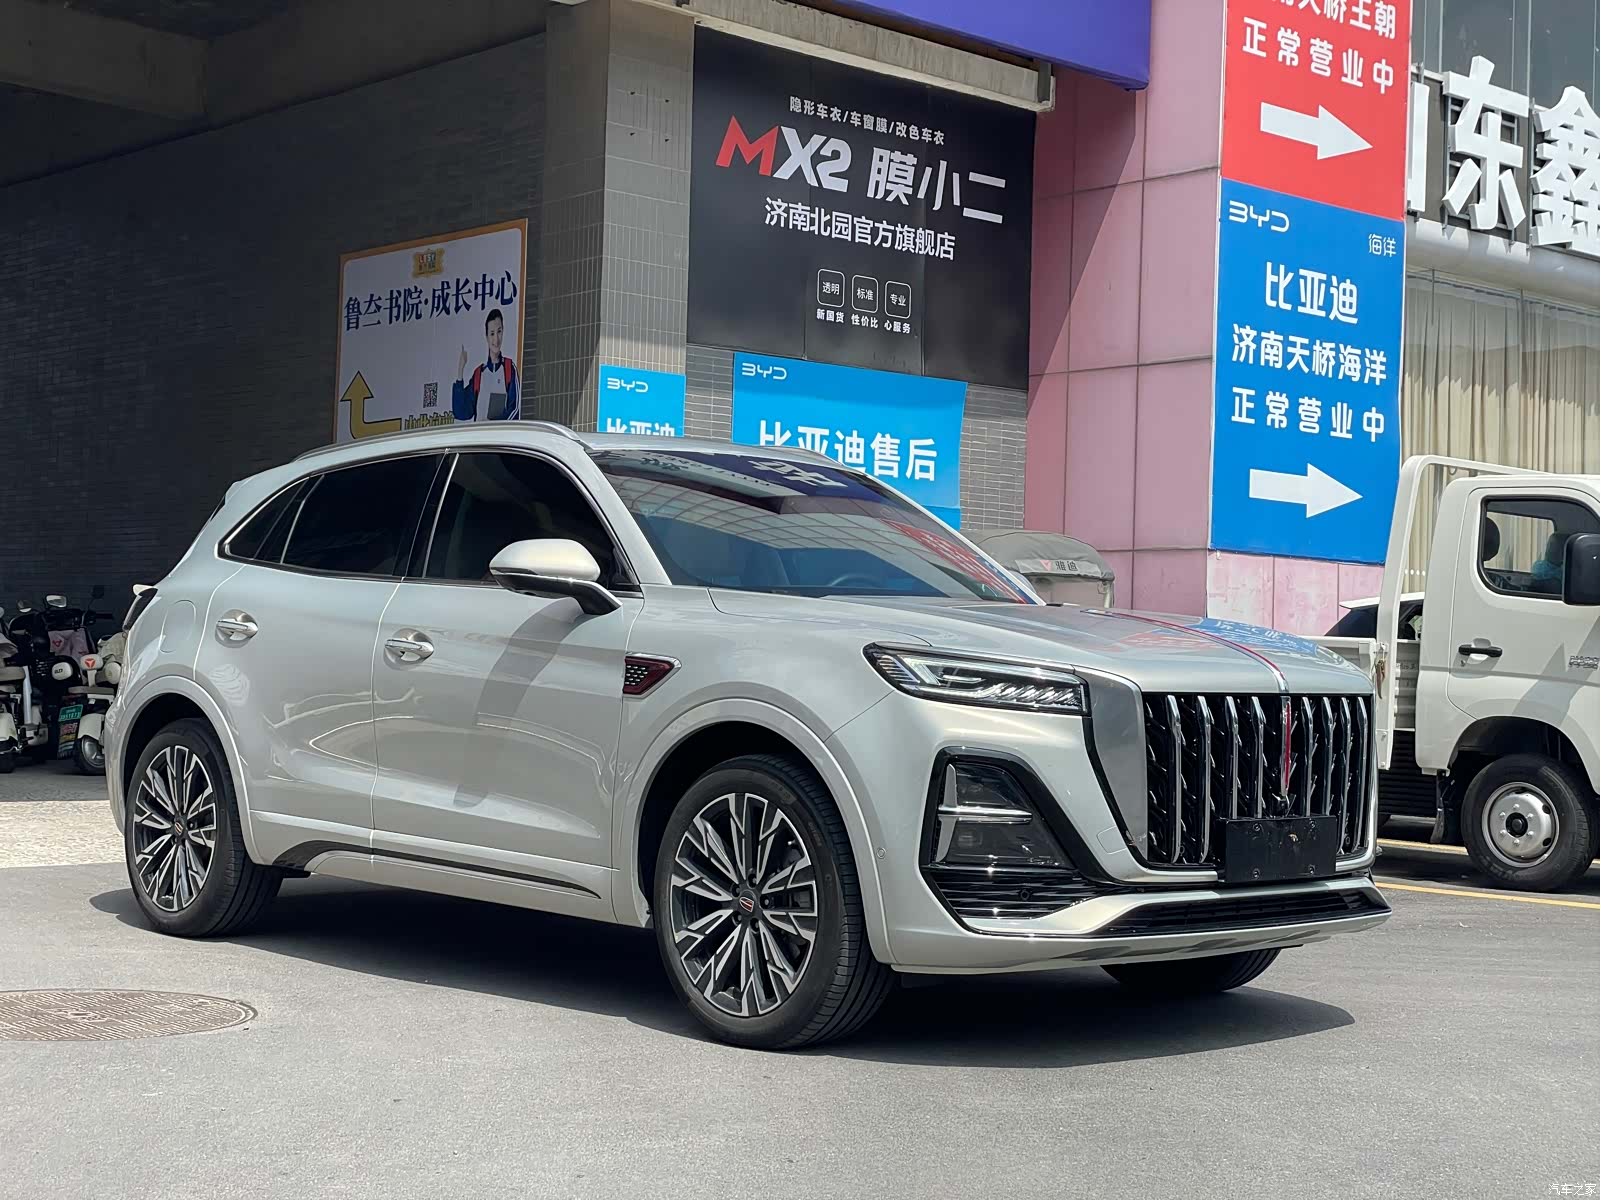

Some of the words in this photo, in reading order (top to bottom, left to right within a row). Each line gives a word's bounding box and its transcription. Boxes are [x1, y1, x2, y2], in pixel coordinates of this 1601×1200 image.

[1243, 17, 1394, 94] 正常营业中
[790, 96, 945, 145] 隐形车衣/车窗膜/改色车衣
[715, 115, 852, 192] MX2
[867, 147, 1006, 223] 膜小二
[1405, 55, 1600, 256] 东鑫
[765, 197, 956, 260] 济南北园官方旗舰店
[1229, 200, 1290, 232] BYD
[1368, 234, 1397, 257] 海洋
[822, 281, 840, 295] 透明
[856, 288, 874, 301] 标准
[890, 294, 907, 307] 专业
[1265, 262, 1359, 324] 比亚迪
[816, 308, 845, 323] 新国货
[851, 313, 879, 328] 性价比
[883, 319, 911, 334] 心服务
[742, 362, 788, 380] BYD
[1232, 323, 1387, 386] 济南天桥海洋
[606, 377, 649, 393] BYD
[1231, 386, 1385, 442] 正常营业中
